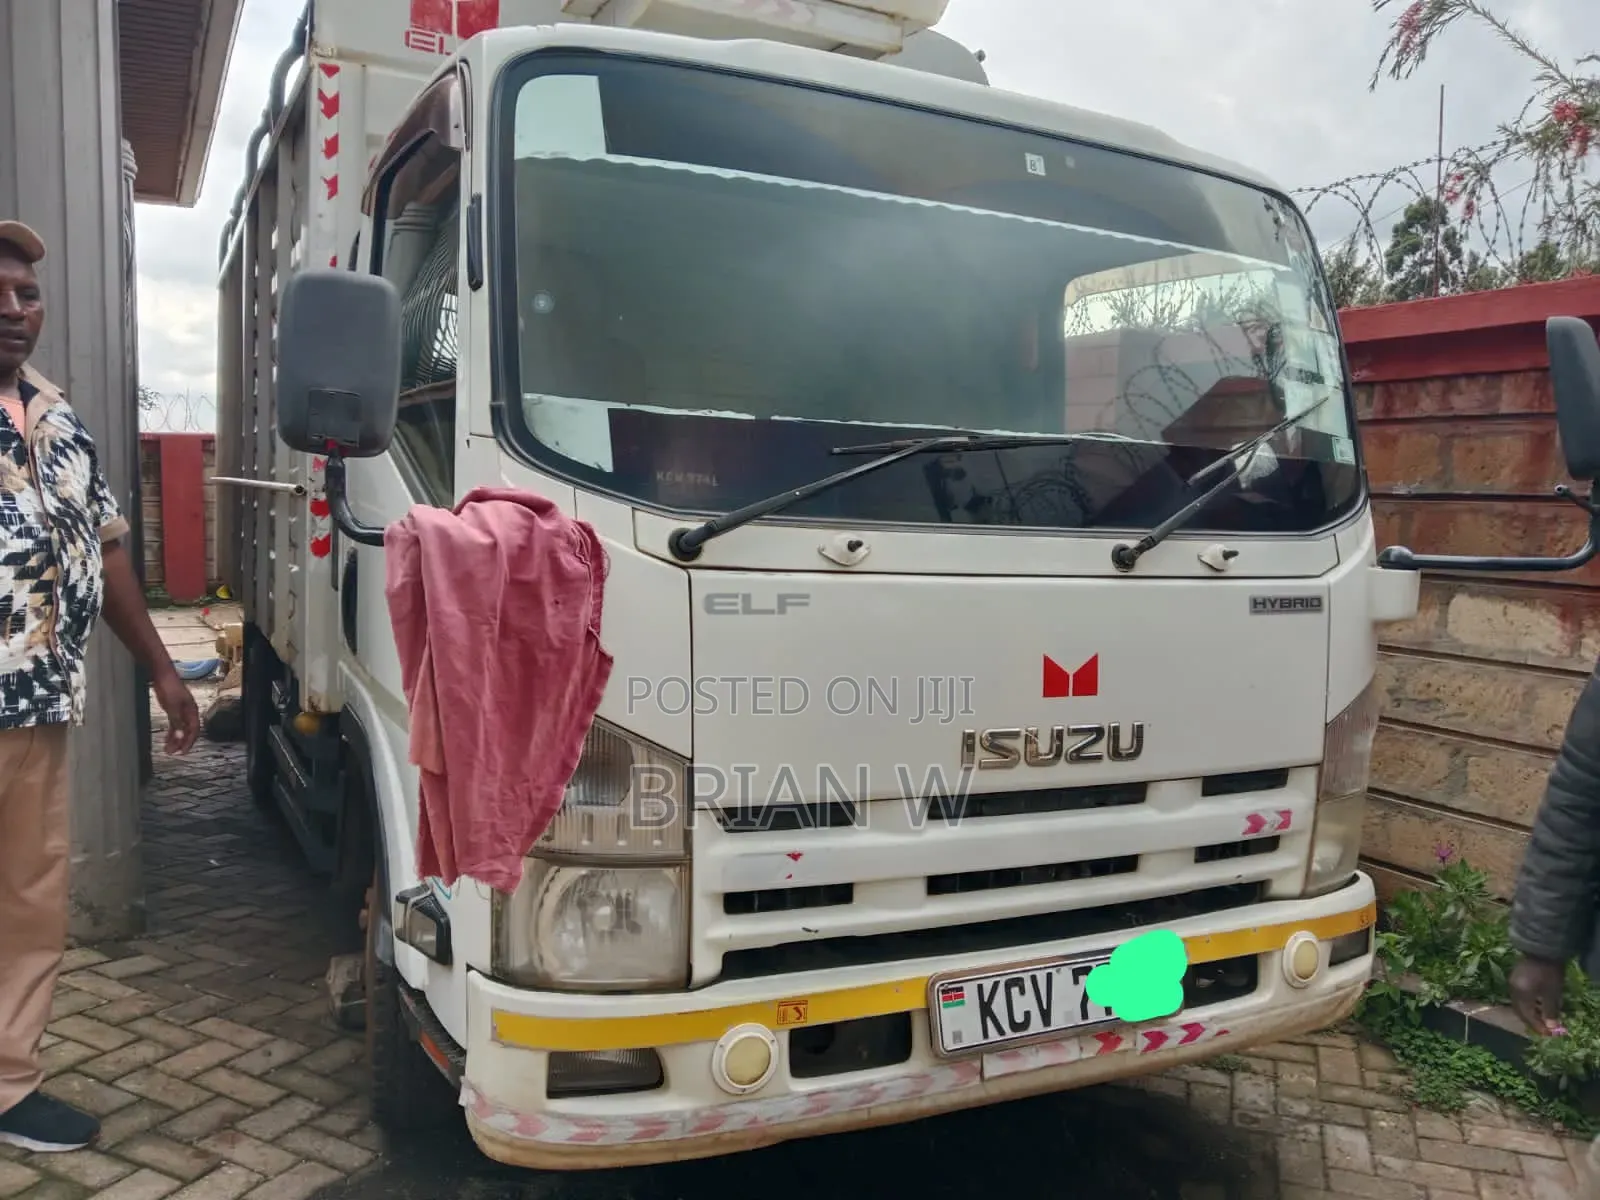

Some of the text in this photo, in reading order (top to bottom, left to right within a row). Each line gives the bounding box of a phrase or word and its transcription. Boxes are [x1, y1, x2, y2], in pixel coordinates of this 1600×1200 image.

[702, 592, 811, 616] ELF
[1251, 596, 1323, 610] HYBRID
[960, 721, 1145, 770] ISUZU
[976, 971, 1054, 1040] KCV
